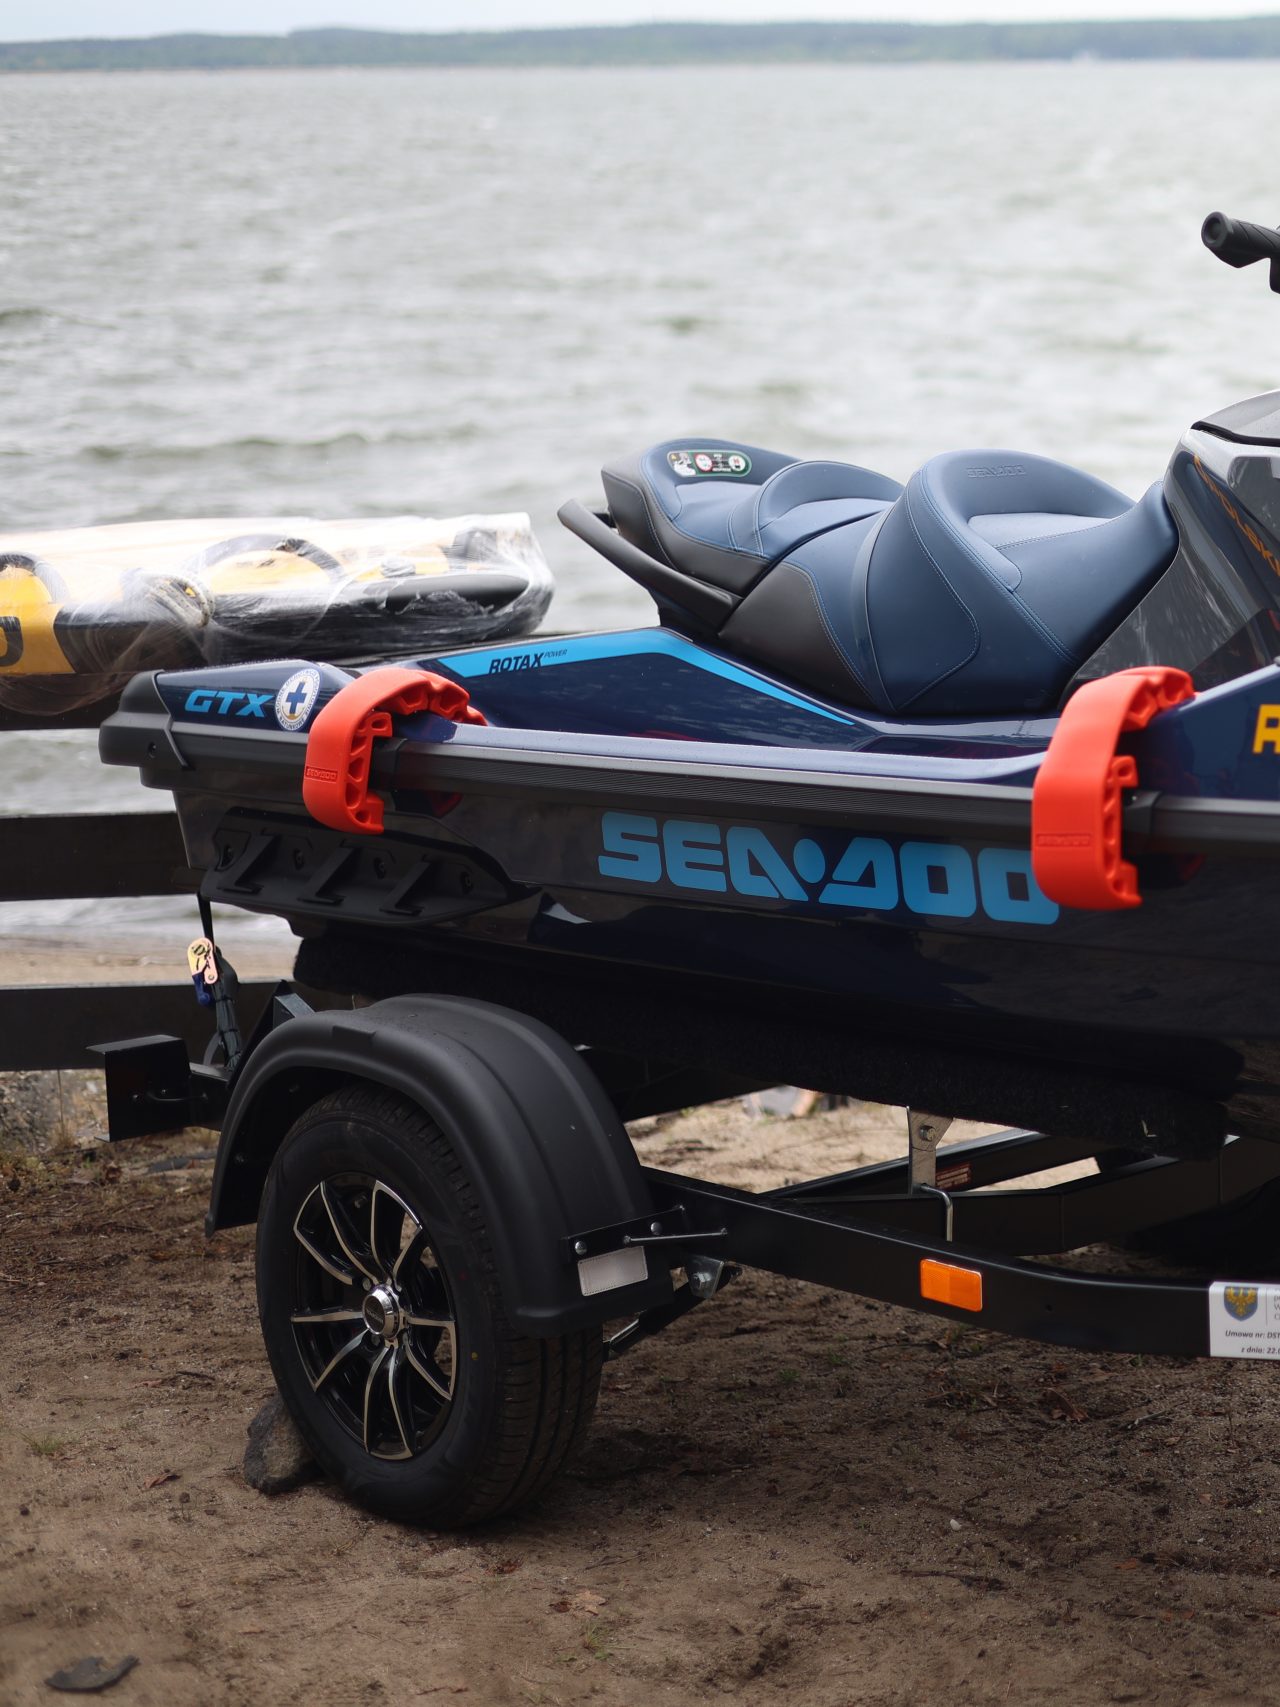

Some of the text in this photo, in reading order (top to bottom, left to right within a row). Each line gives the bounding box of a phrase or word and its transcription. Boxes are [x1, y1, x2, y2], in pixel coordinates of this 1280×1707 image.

[488, 652, 545, 674] ROTAX
[184, 689, 275, 718] GTX
[1225, 1329, 1253, 1338] Umowa
